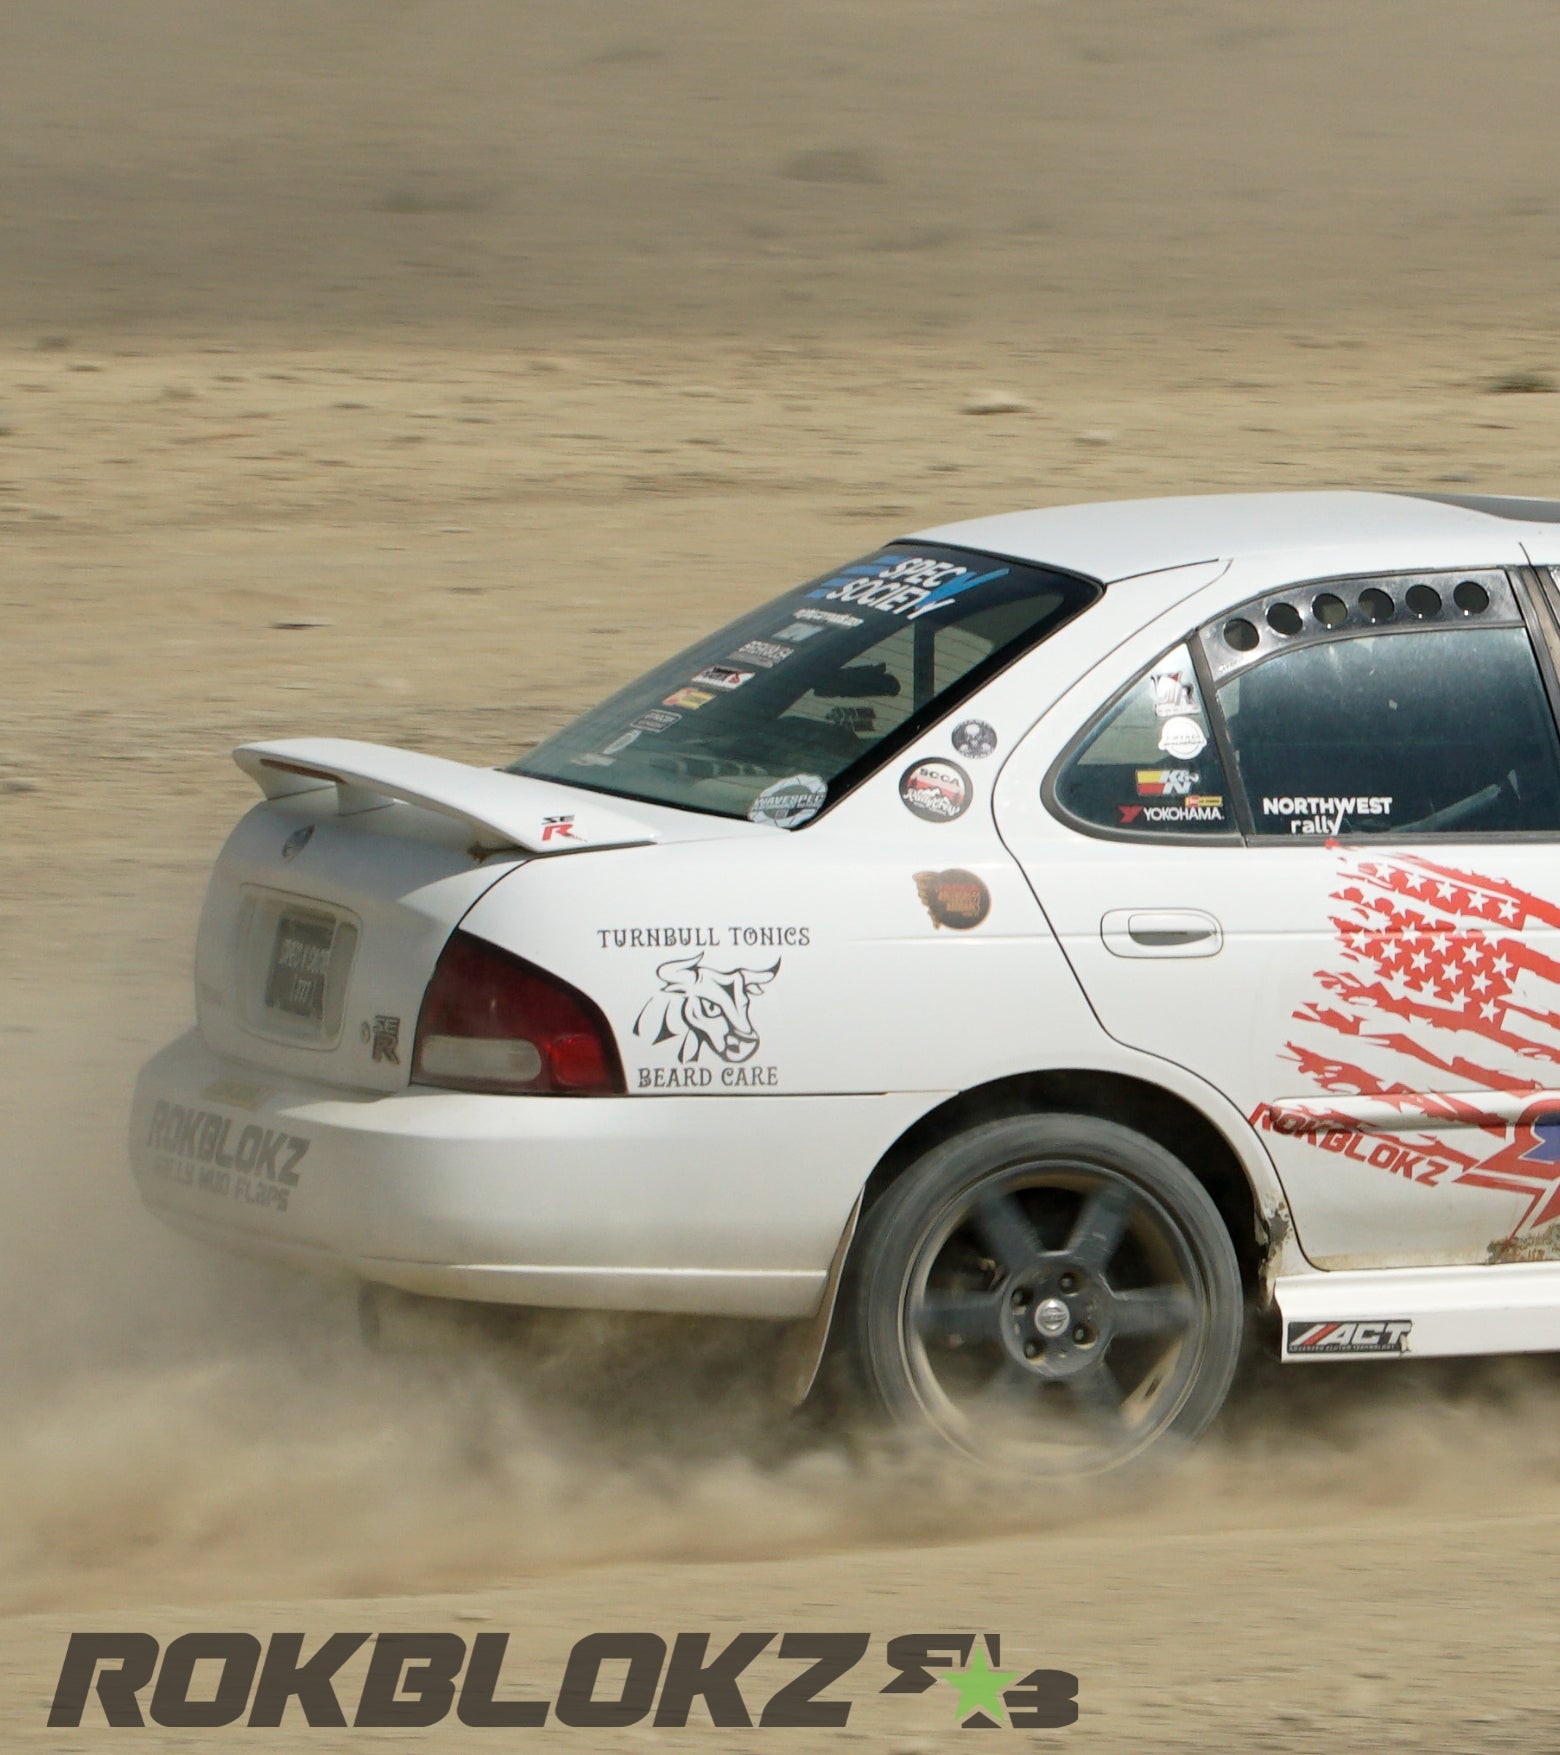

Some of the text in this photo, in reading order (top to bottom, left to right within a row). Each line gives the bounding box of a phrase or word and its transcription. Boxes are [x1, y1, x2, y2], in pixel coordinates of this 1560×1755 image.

[879, 557, 968, 588] SPEC
[826, 577, 956, 620] SOCIETY
[919, 768, 960, 786] SCCA
[1143, 806, 1223, 821] YOKOHAMA
[1262, 797, 1393, 817] NORTHWEST
[1291, 814, 1344, 836] rally
[597, 926, 811, 948] TURNBULL TONICS
[638, 1066, 778, 1088] BEARD CARE
[147, 1100, 311, 1187] ROKBLOKZ
[1249, 1102, 1454, 1188] ROKBLOKZ
[1312, 1322, 1412, 1346] ACT
